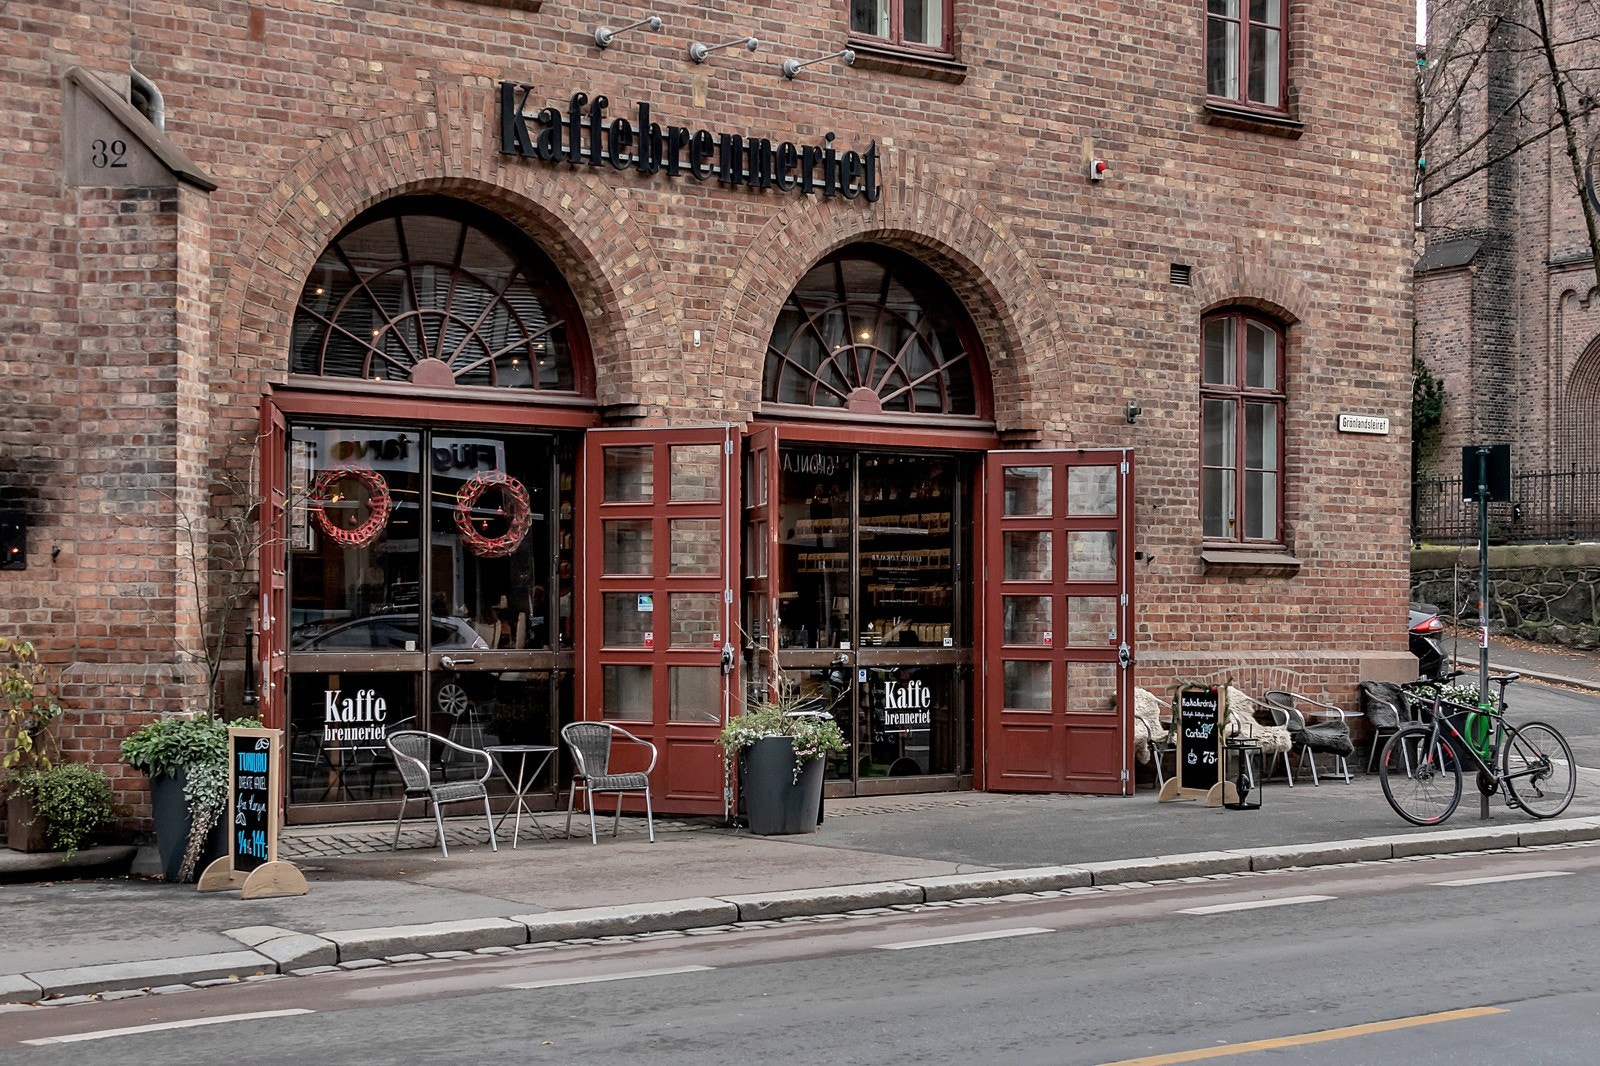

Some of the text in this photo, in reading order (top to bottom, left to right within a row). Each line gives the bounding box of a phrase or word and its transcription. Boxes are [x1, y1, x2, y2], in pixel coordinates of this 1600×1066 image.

[92, 139, 127, 168] 32
[499, 81, 881, 203] Kaffebrenneriet
[324, 689, 387, 722] Kaffe
[884, 680, 931, 709] Kaffe
[884, 709, 931, 726] brenneriet
[324, 724, 387, 741] brenneriet
